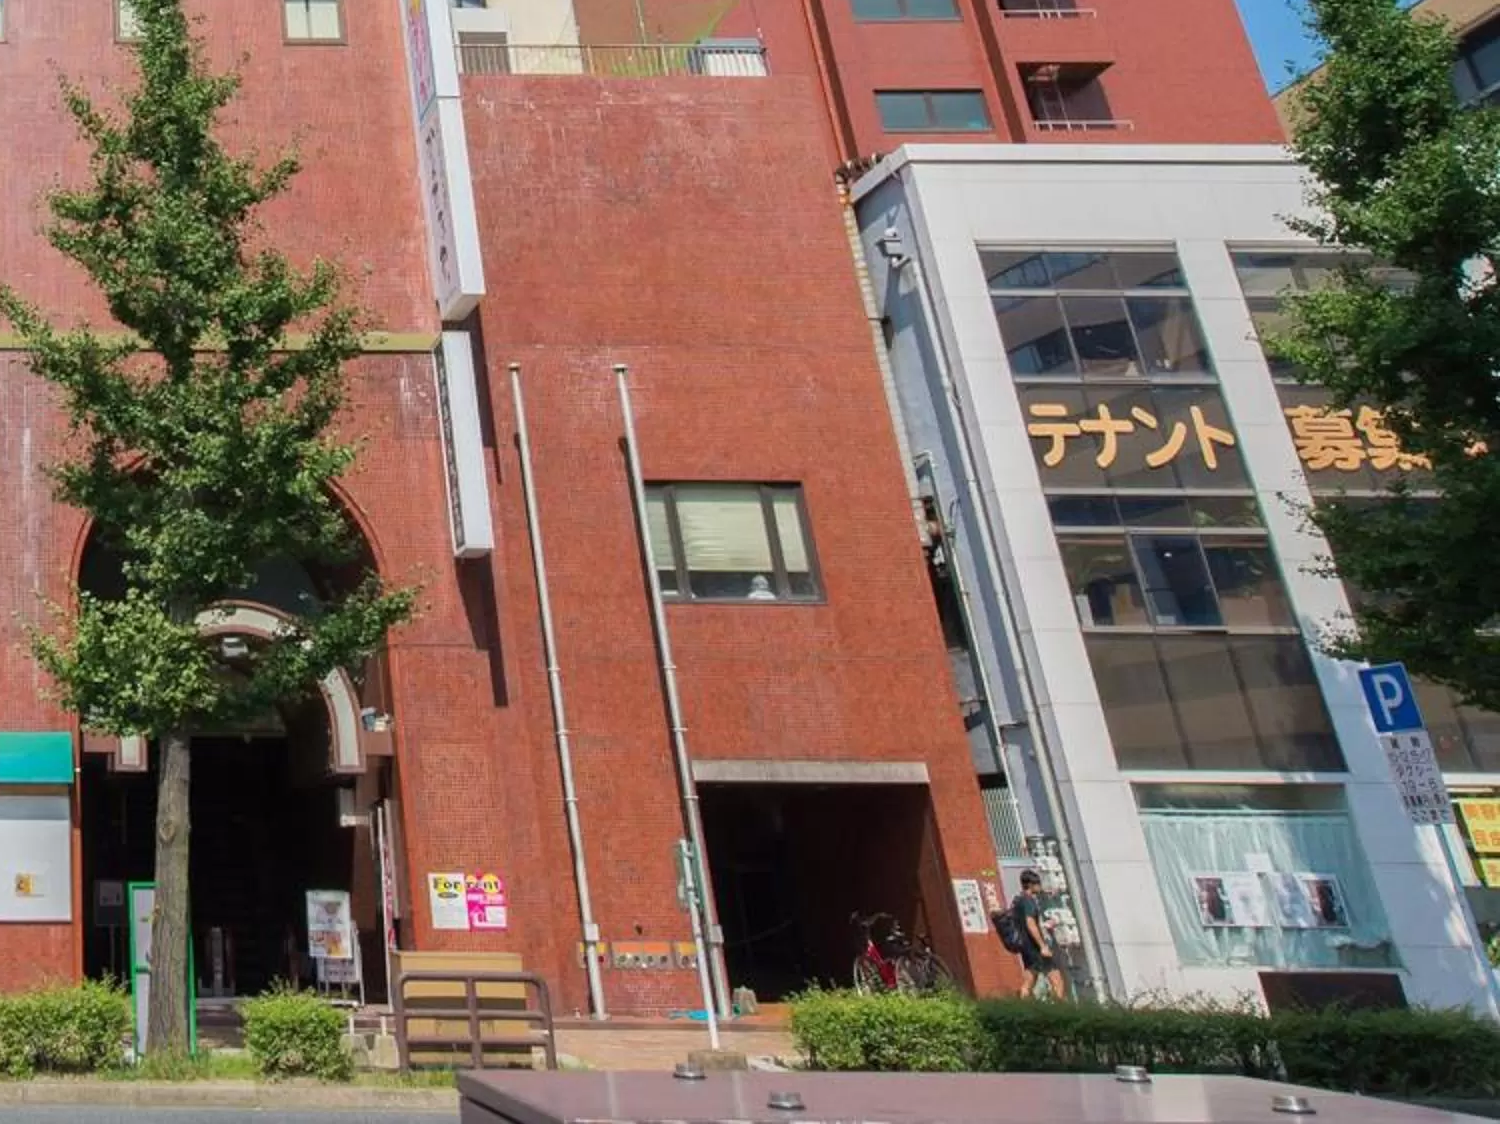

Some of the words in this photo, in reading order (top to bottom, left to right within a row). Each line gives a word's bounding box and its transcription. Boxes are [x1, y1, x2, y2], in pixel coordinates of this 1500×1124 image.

[1027, 403, 1235, 470] テナント
[1284, 403, 1488, 472] 募集
[1371, 673, 1404, 726] P
[433, 877, 461, 890] For
